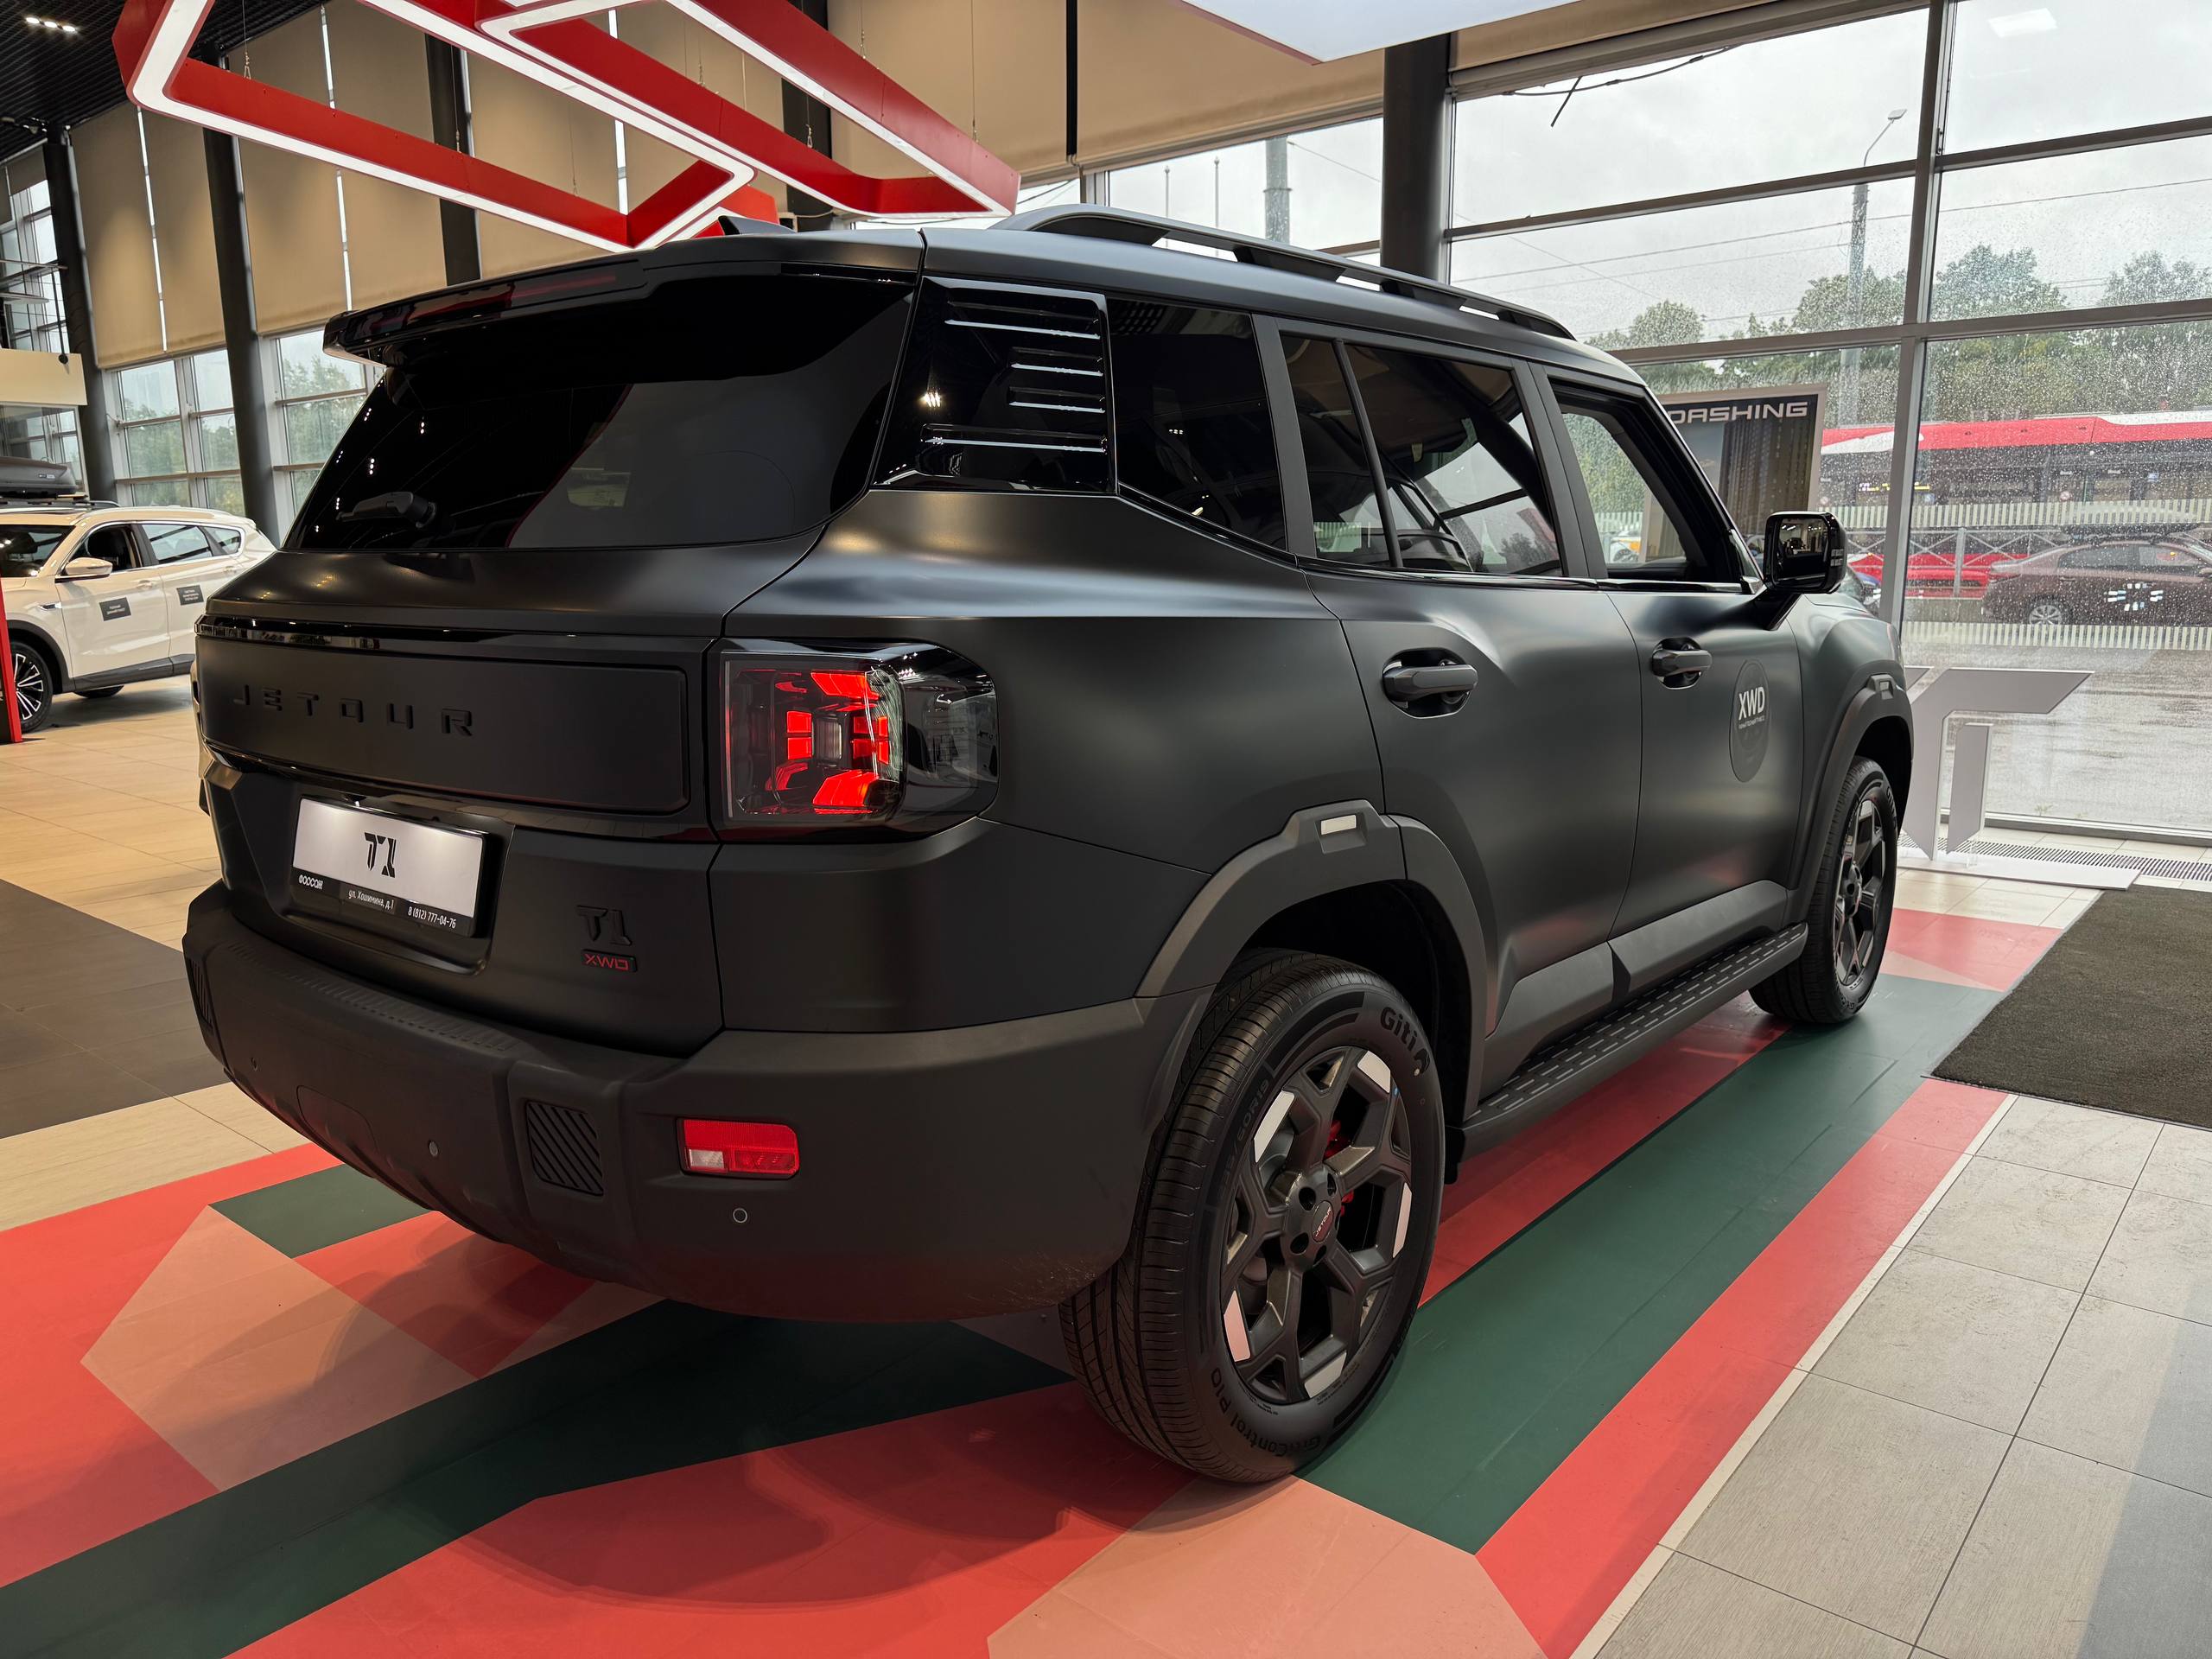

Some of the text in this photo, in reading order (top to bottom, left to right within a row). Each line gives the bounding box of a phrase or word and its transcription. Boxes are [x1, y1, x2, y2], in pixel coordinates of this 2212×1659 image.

[1668, 401, 1808, 424] DASHING
[233, 683, 473, 736] JETOUR
[1738, 686, 1765, 721] XWD
[364, 832, 397, 878] T1
[348, 889, 357, 899] ул.
[357, 890, 385, 907] Хошимина,
[408, 906, 456, 929] 8 (812) 777-04-76
[575, 905, 632, 946] T1
[583, 953, 629, 971] XWD
[1380, 1007, 1417, 1052] Giti
